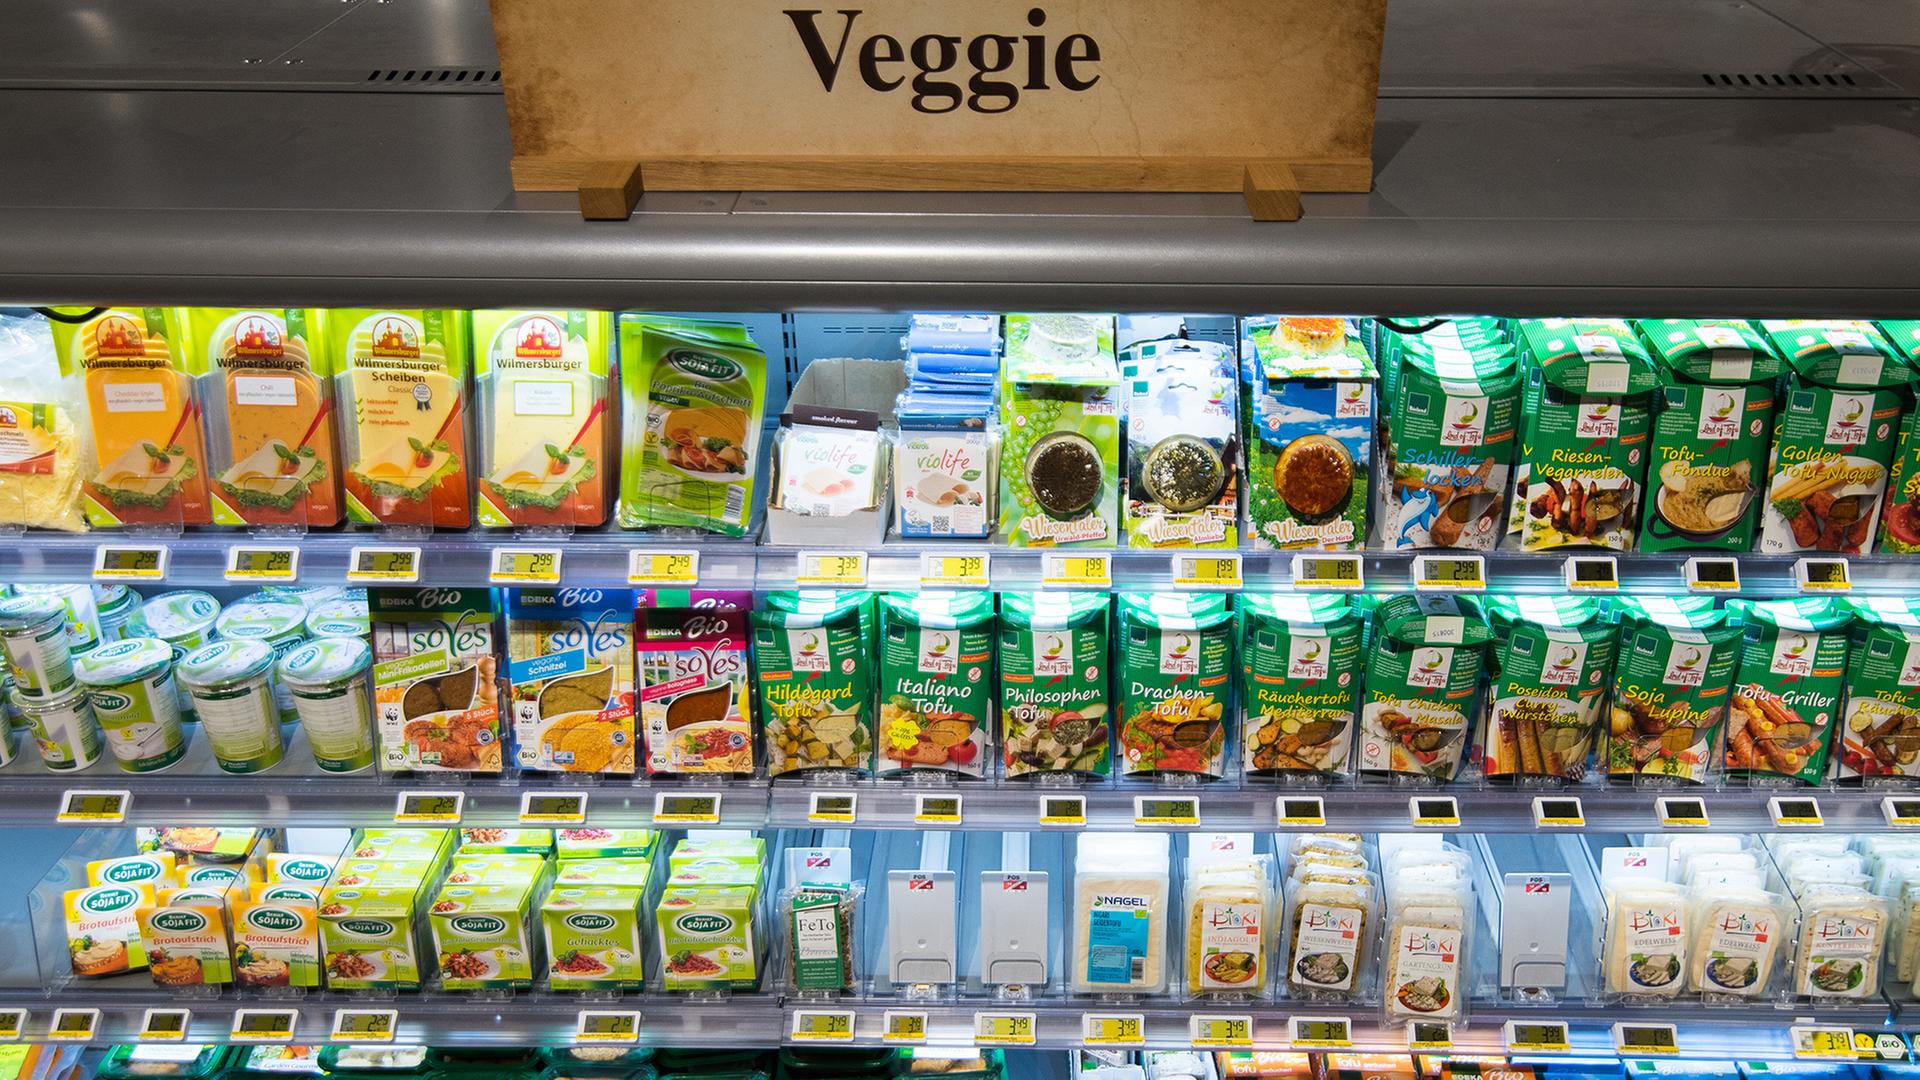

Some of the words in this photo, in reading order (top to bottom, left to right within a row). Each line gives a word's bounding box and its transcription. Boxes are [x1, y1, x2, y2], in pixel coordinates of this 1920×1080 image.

[782, 8, 1101, 114] Veggie
[374, 348, 419, 356] Wilmersburger
[80, 360, 166, 369] Wilmersburger
[216, 358, 304, 369] Wilmersburger
[354, 359, 440, 372] Wilmersburger
[497, 359, 582, 369] Wilmersburger
[680, 357, 708, 371] SOJA
[711, 365, 730, 374] FIT
[372, 372, 426, 383] Scheiben
[1578, 422, 1594, 433] Lord
[1602, 422, 1617, 434] Tofu
[1404, 449, 1485, 467] Schiller-
[1552, 449, 1611, 463] Riesen-
[1660, 446, 1704, 461] Tofu-
[1782, 446, 1842, 462] Golden
[1424, 468, 1482, 487] locken
[1535, 464, 1624, 481] Vegarnelen
[1672, 463, 1730, 479] Fondue
[1026, 516, 1104, 536] Wiesentaler
[1149, 517, 1223, 540] Wiesentaler
[1272, 518, 1352, 540] Wiesentaler
[380, 598, 414, 606] EDEKA
[417, 589, 461, 609] Bio
[520, 596, 555, 605] EDEKA
[559, 588, 603, 607] Bio
[646, 629, 681, 637] EDEKA
[683, 616, 729, 639] Bio
[378, 658, 446, 680] Mini-Frikadellen
[528, 660, 567, 674] Schnitzel
[794, 658, 808, 668] Lord
[815, 658, 829, 669] Tofu
[1162, 659, 1177, 669] Lord
[1183, 660, 1198, 671] Tofu
[668, 677, 698, 689] Bolognese
[1542, 670, 1558, 681] Lord
[1565, 670, 1579, 683] Tofu
[767, 682, 852, 704] Hildegard
[896, 678, 972, 698] Italiano
[1131, 682, 1215, 699] Drachen-
[1507, 683, 1569, 700] Poseidon
[1625, 684, 1665, 705] Soja
[1005, 688, 1101, 705] Philosophen
[1257, 689, 1350, 706] Räuchertofu
[1372, 690, 1402, 708] Tofu
[1407, 698, 1462, 712] Chicken
[1735, 684, 1835, 708] Tofu-Griller
[1875, 690, 1915, 703] Tofu-
[775, 704, 813, 718] Tofu
[912, 699, 954, 714] Tofu
[1151, 701, 1189, 716] Tofu
[1260, 704, 1346, 719] Mediterran
[1515, 698, 1566, 712] Curry-
[472, 707, 495, 719] Stück
[607, 707, 631, 718] Stück
[1011, 705, 1046, 720] Tofu
[1415, 713, 1463, 726] Masala
[1501, 708, 1578, 724] Würstchen
[1648, 707, 1710, 722] Lupine
[114, 869, 137, 880] SOJA
[137, 867, 153, 877] FIT
[290, 868, 310, 876] SOJA
[310, 868, 325, 877] FIT
[91, 896, 114, 908] SOJA
[114, 895, 130, 905] FIT
[1104, 896, 1147, 907] NAGEL
[161, 918, 184, 927] SOJA
[185, 917, 198, 925] FIT
[257, 916, 281, 925] SOJA
[281, 917, 296, 925] FIT
[687, 921, 710, 929] SOJA
[799, 919, 835, 932] FeTo
[153, 934, 217, 945] Brotaufstrich
[245, 934, 309, 945] Brotaufstrich
[567, 938, 620, 947] Gehacktes
[1719, 938, 1761, 951] EDELWEISS
[1230, 1064, 1257, 1074] Tofu
[1337, 1059, 1361, 1069] Tofu
